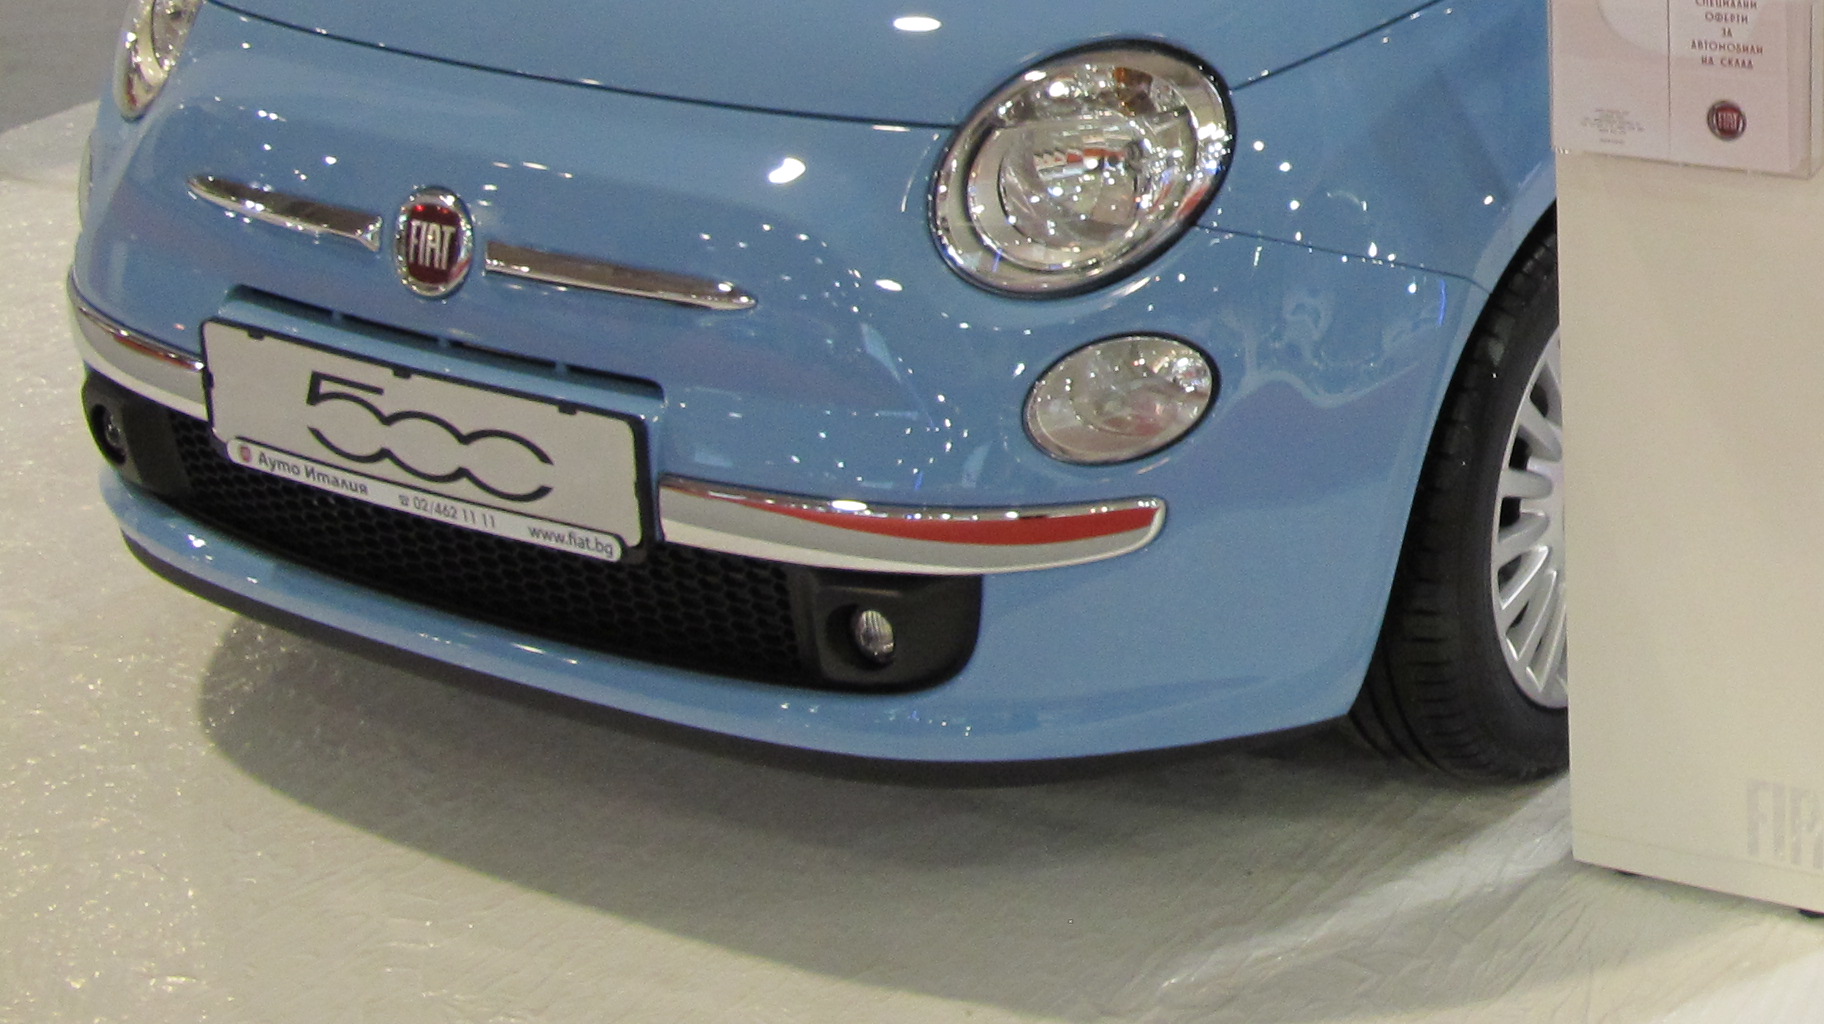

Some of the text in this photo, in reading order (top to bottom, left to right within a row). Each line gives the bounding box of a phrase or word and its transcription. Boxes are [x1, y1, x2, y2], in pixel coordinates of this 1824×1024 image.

[1705, 11, 1748, 24] ОФЕРТИ
[1691, 39, 1763, 55] АВТОМОБИЛИ
[1701, 55, 1753, 69] НА СКЛАД
[409, 219, 456, 270] FIAT
[306, 370, 554, 503] 500
[413, 496, 496, 528] 02/462 11 11
[528, 526, 614, 558] www.fiat.bg
